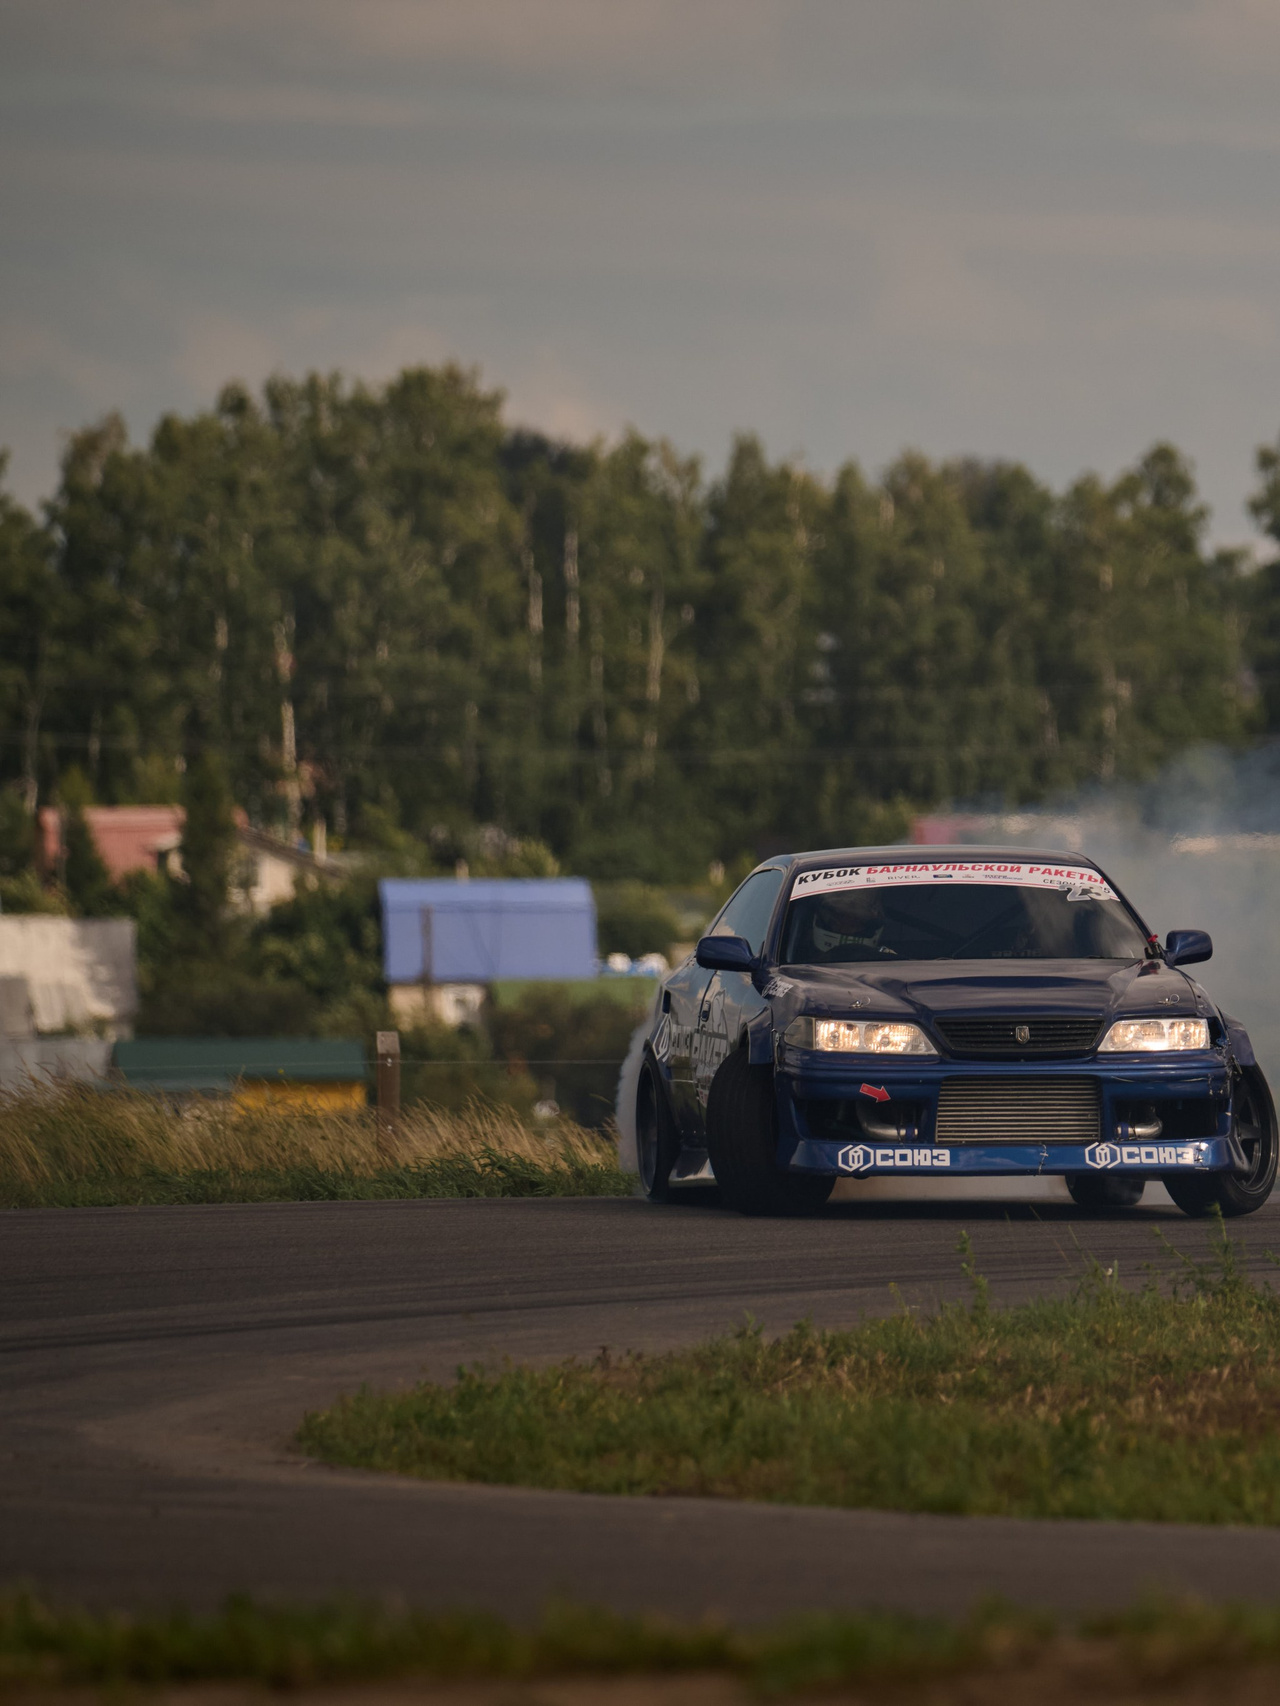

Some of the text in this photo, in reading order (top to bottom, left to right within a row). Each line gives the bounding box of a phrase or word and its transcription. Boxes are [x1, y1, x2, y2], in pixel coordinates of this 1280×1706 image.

[798, 864, 1105, 885] КУБОК БАРНАУЛЬСКОЙ РАКЕТЫ
[876, 1149, 950, 1166] СОЮЗ
[1121, 1147, 1194, 1164] СОЮЗ
